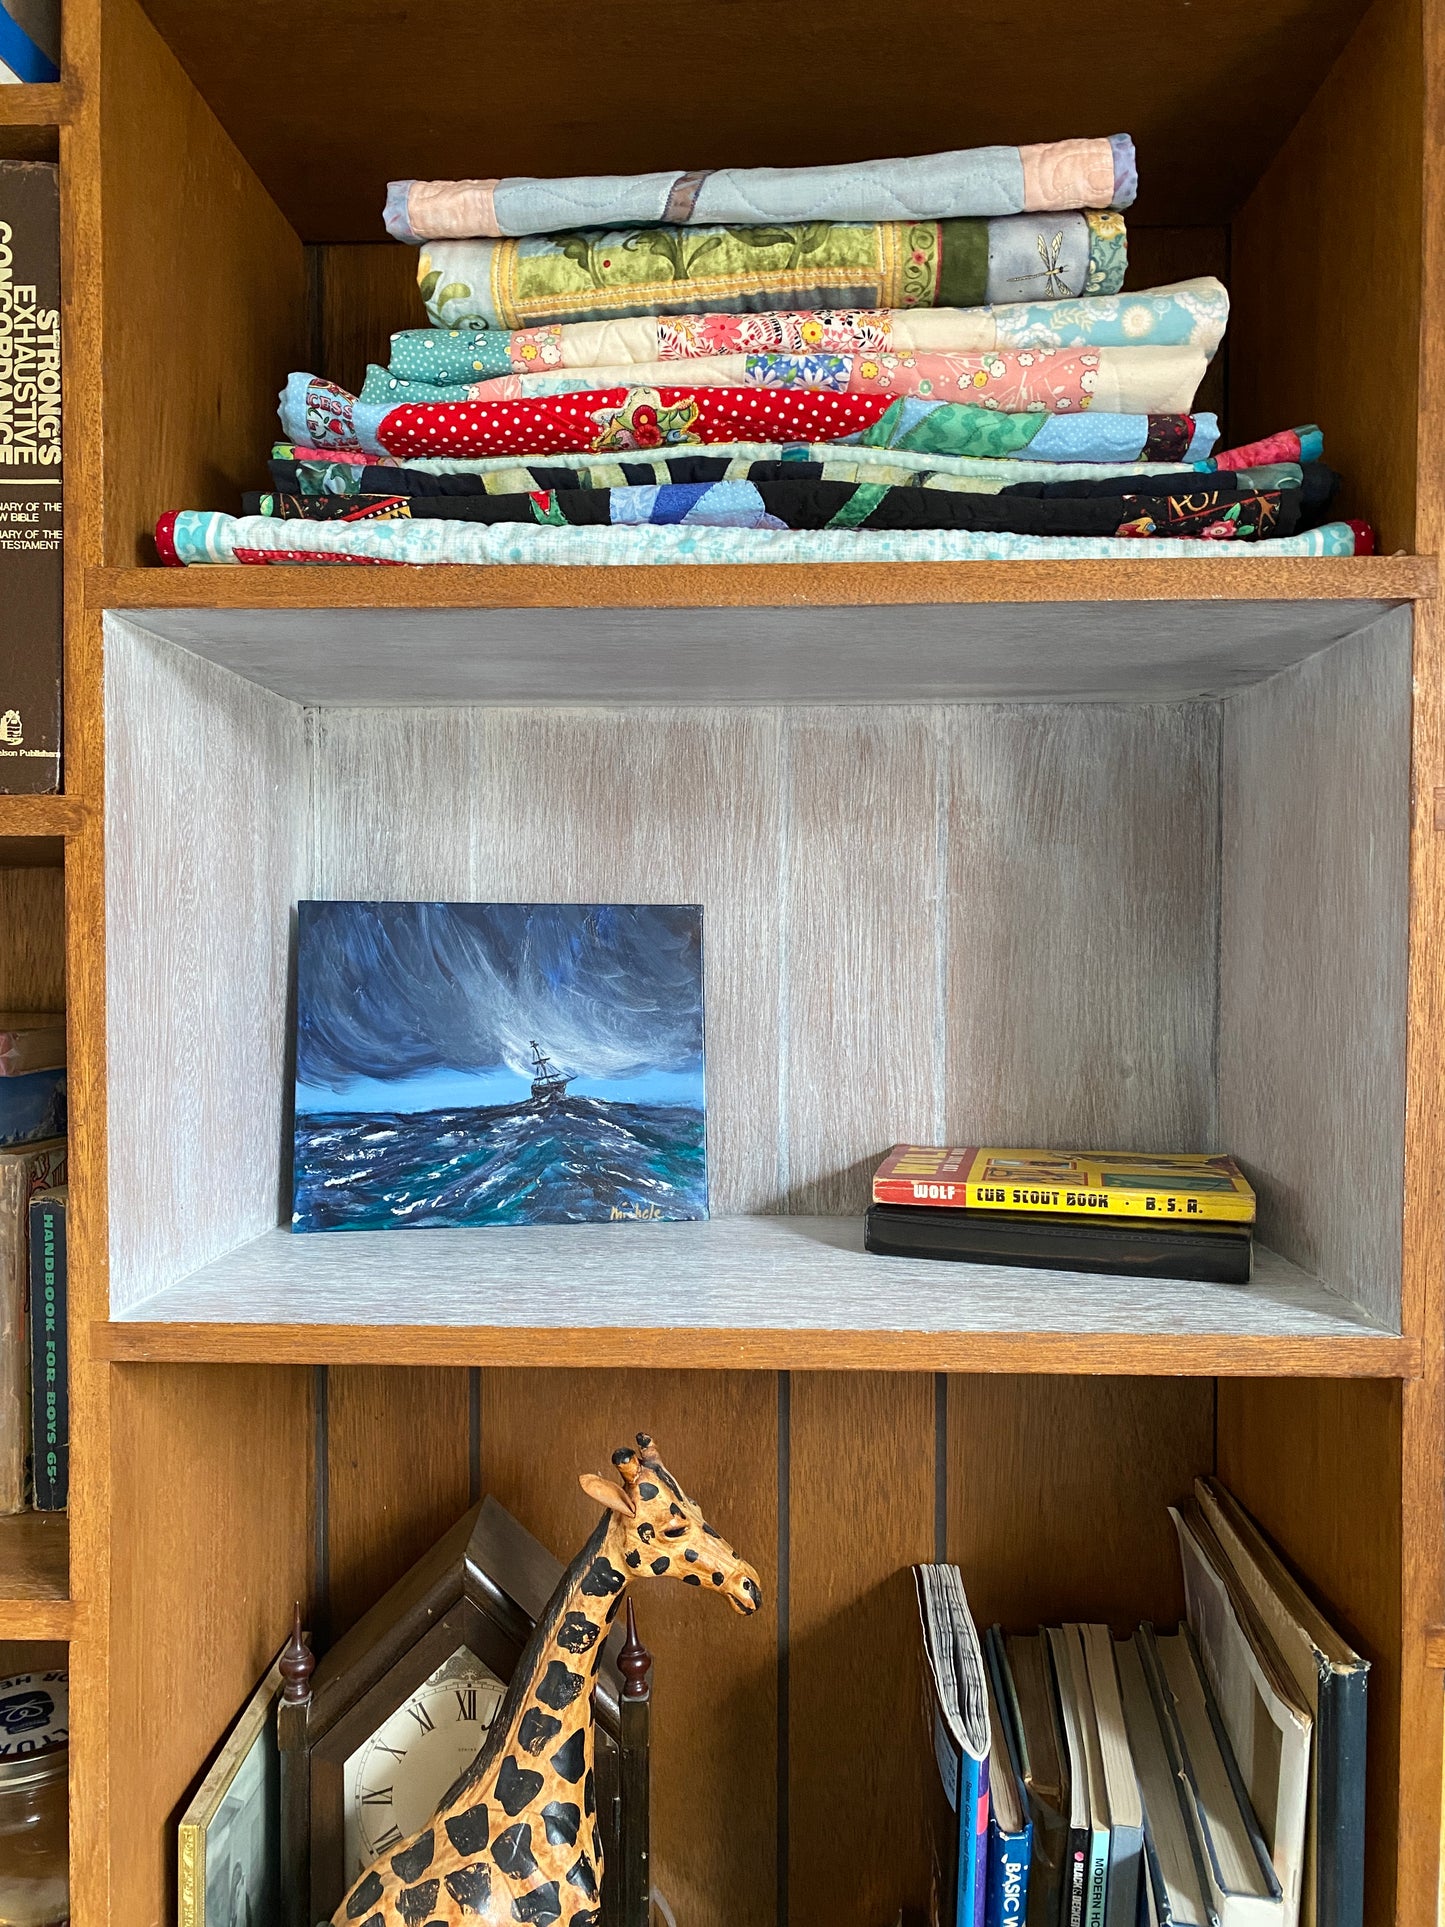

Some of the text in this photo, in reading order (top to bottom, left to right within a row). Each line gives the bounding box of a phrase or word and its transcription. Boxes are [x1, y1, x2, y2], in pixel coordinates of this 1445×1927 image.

[13, 285, 38, 465] EXHAUSTIVE
[37, 308, 62, 466] STRONG'S
[10, 512, 40, 523] BIBLE
[25, 502, 40, 512] OF
[43, 502, 63, 512] THE
[1, 540, 60, 550] TESTAMENT
[24, 529, 40, 539] OF
[42, 529, 63, 540] THE
[913, 1183, 956, 1200] WOLF
[976, 1188, 1006, 1202] CUB
[1012, 1189, 1061, 1206] SCOUT
[1066, 1192, 1109, 1209] BOOK
[43, 1214, 56, 1331] HANDBOOK
[46, 1341, 56, 1382] FOR
[46, 1391, 57, 1445] BOYS
[406, 1702, 436, 1737] XI
[455, 1690, 478, 1722] XII
[373, 1737, 408, 1765] X
[361, 1785, 394, 1807] IX
[1003, 1862, 1022, 1912] BASIC
[1092, 1858, 1104, 1909] MODERN
